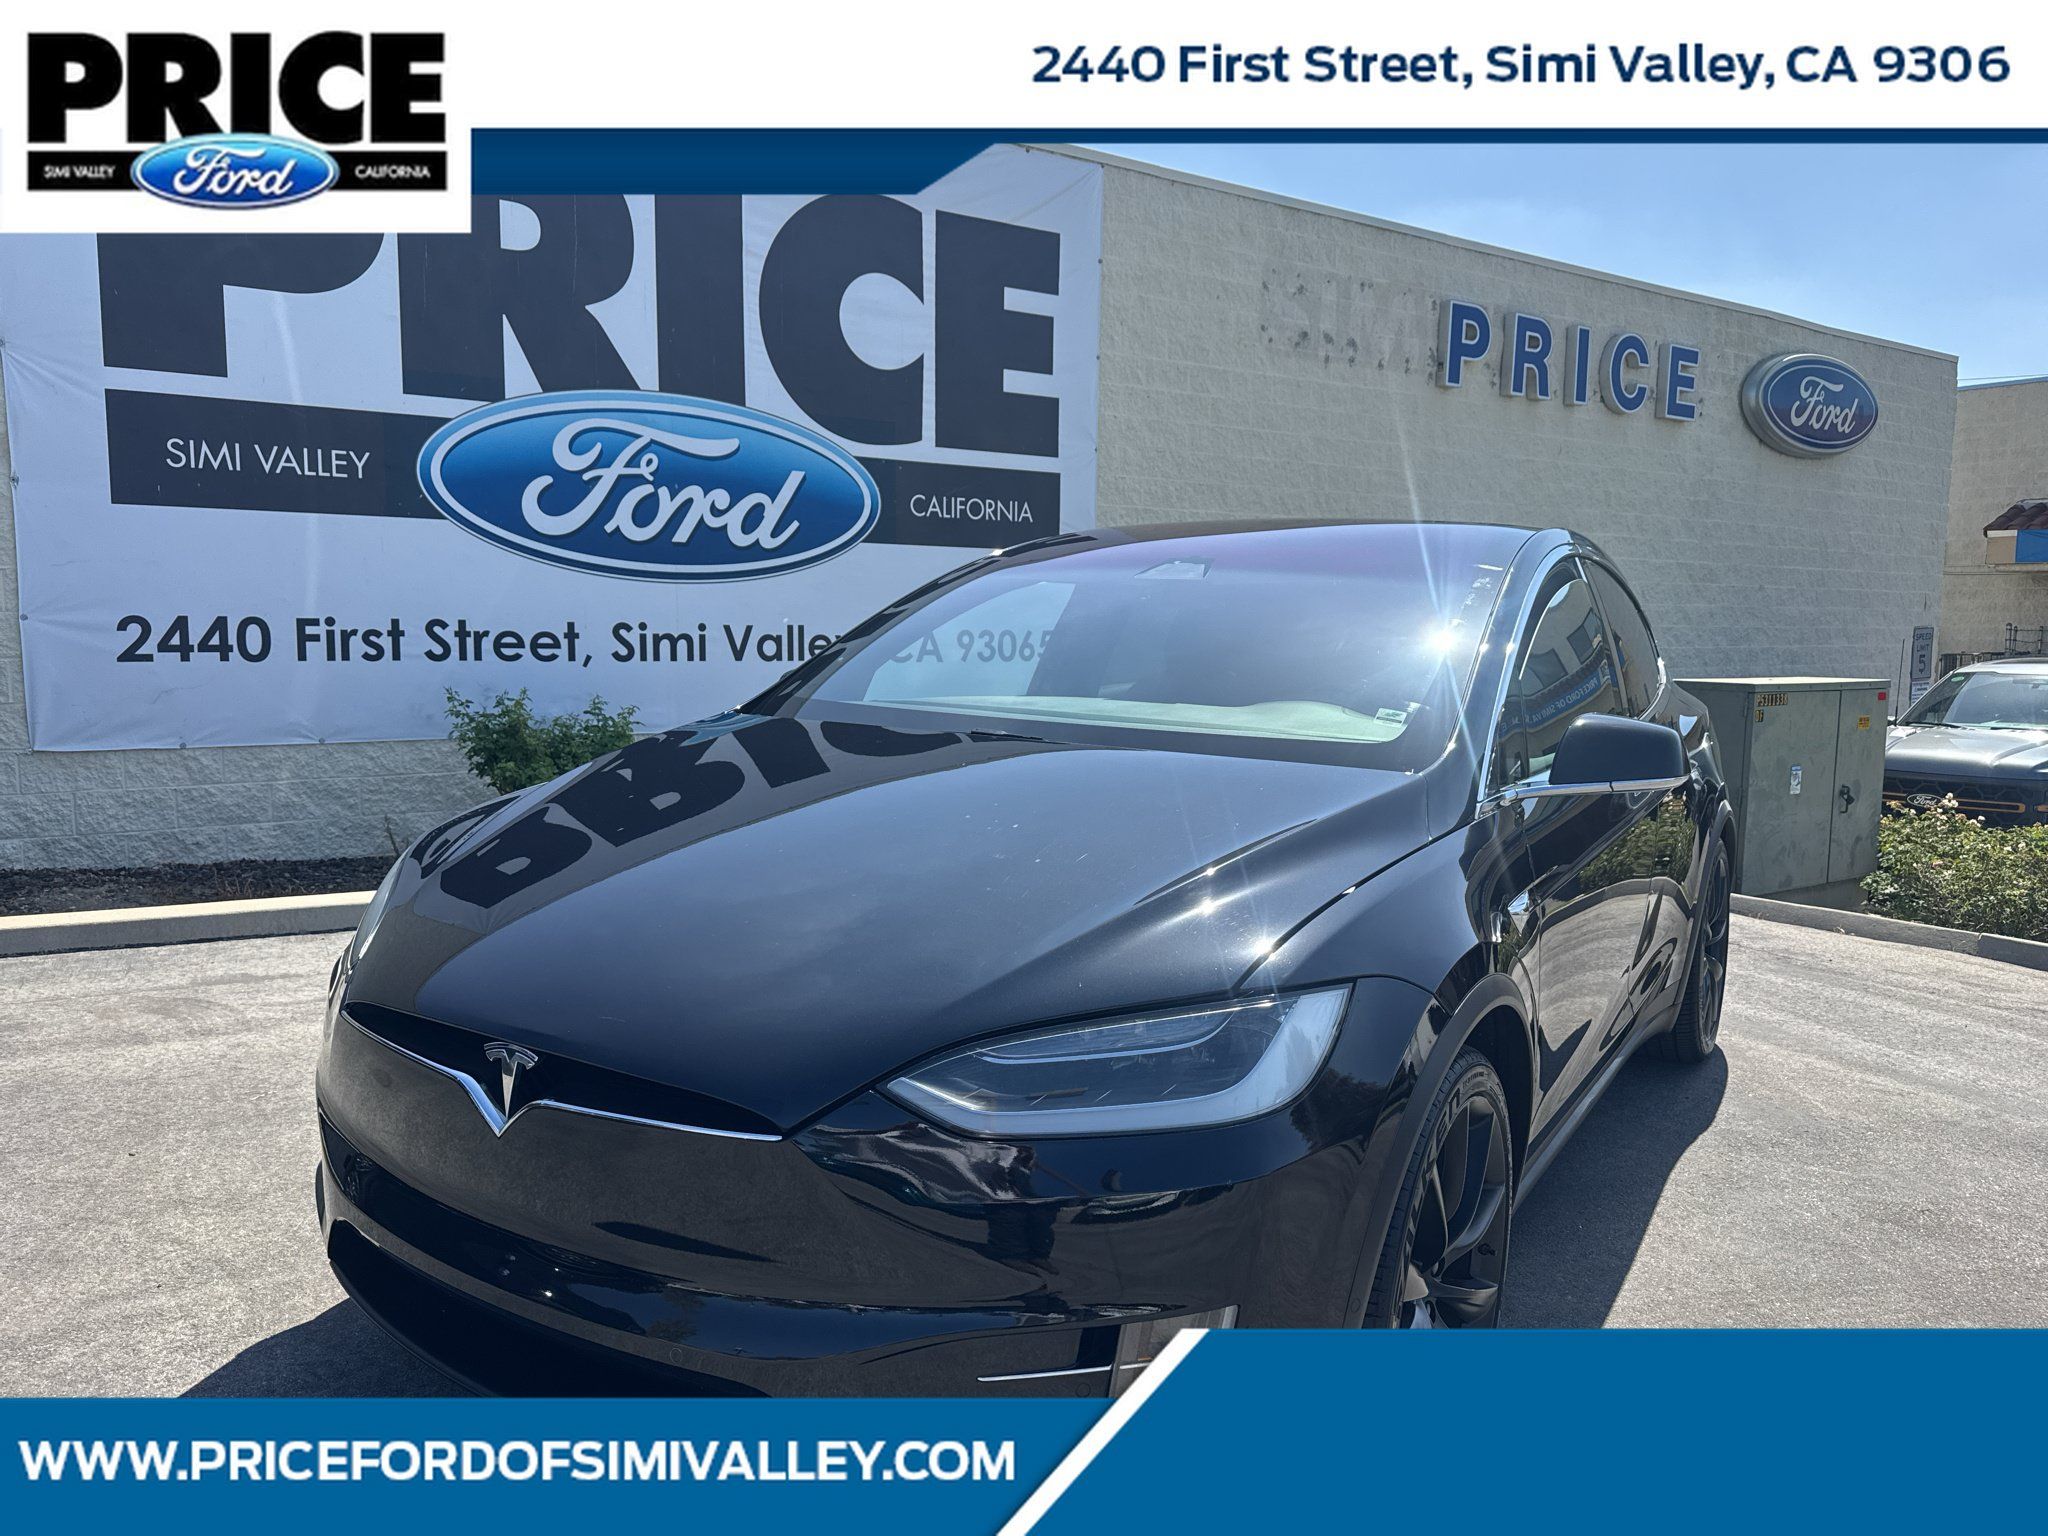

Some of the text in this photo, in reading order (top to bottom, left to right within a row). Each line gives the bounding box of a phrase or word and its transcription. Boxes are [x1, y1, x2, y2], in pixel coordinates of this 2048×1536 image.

[1440, 299, 1700, 422] PRICE
[1790, 376, 1858, 434] Ford
[166, 438, 370, 479] SIMI VALLEY
[521, 418, 806, 551] Ford
[911, 494, 1033, 523] CALIFORNIA
[117, 615, 271, 662] 2440
[296, 617, 405, 661] First
[424, 619, 592, 667] Street,
[611, 622, 706, 663] Simi
[723, 624, 842, 662] Valle
[1915, 632, 1931, 641] SPEED
[1916, 644, 1930, 652] LIMIT
[1918, 654, 1926, 674] 5
[1913, 797, 1938, 806] Ford
